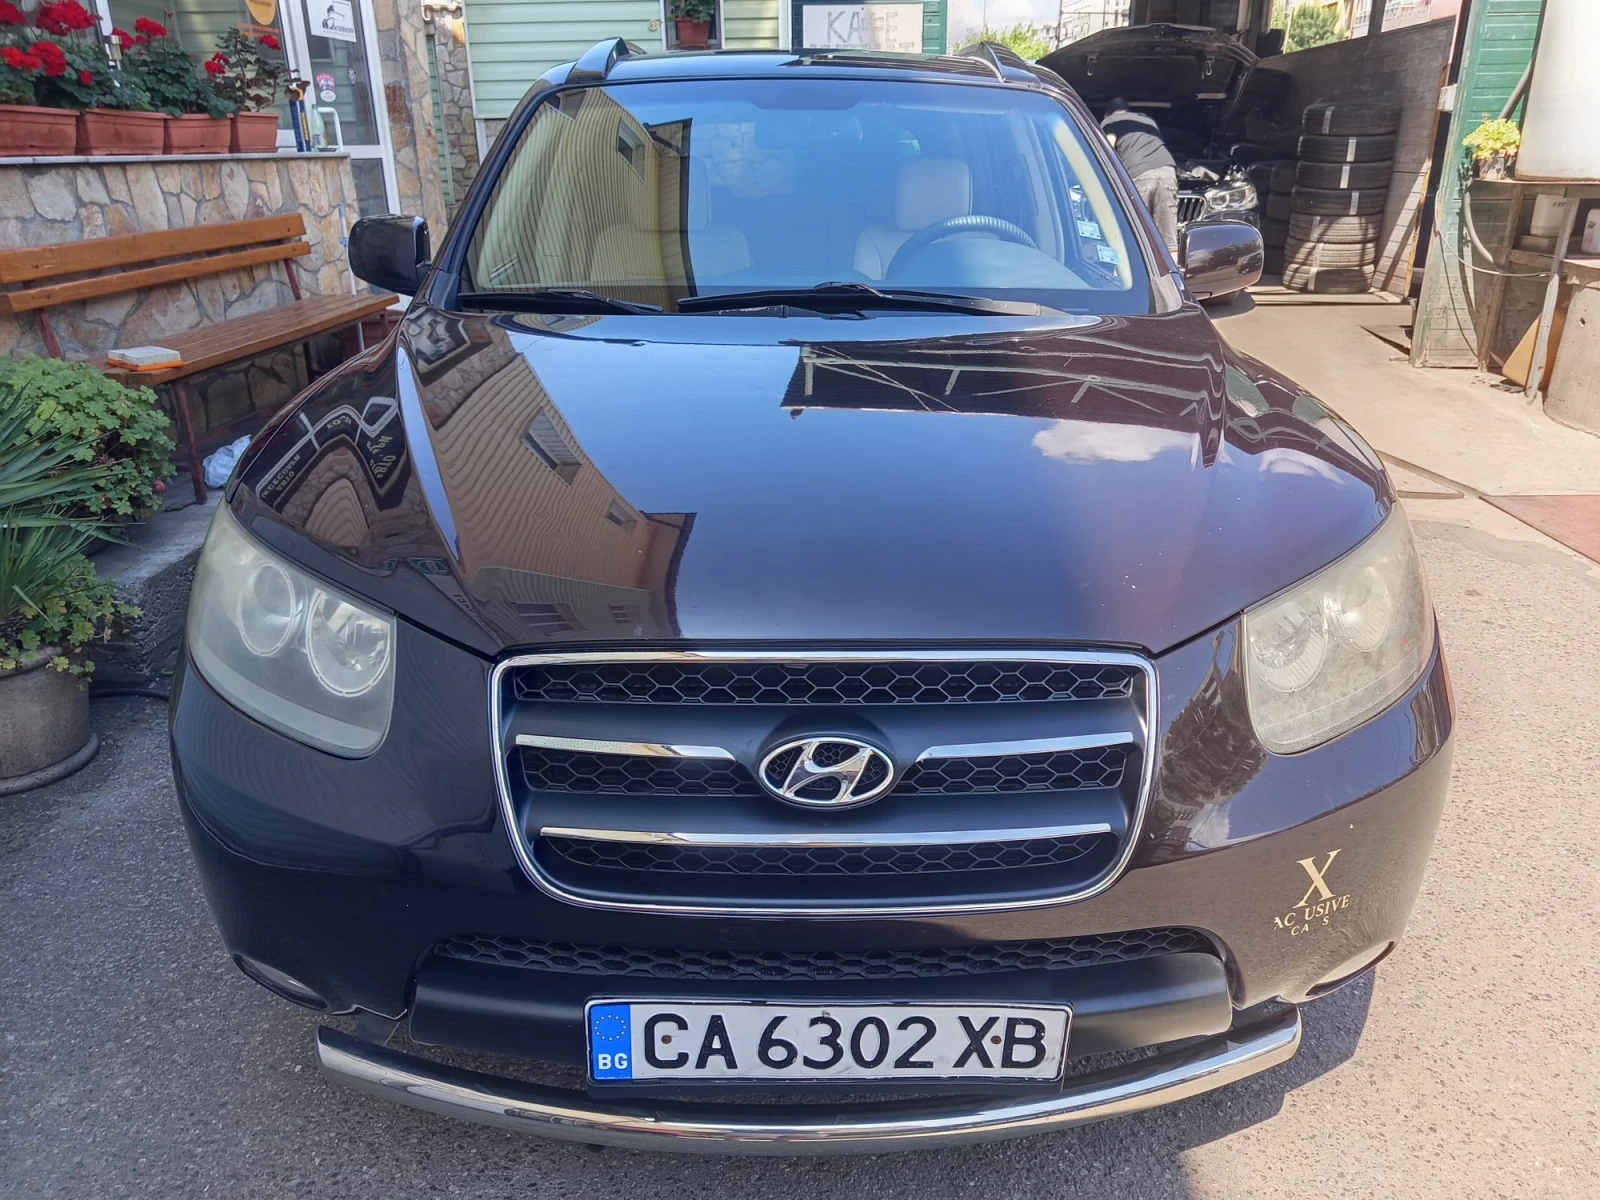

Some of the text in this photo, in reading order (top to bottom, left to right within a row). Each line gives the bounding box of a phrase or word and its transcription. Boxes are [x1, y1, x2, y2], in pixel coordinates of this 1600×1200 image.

[1292, 848, 1342, 909] X
[1291, 915, 1330, 937] CAS
[644, 1013, 1047, 1070] CA 6302 XB
[597, 1053, 628, 1070] BG
